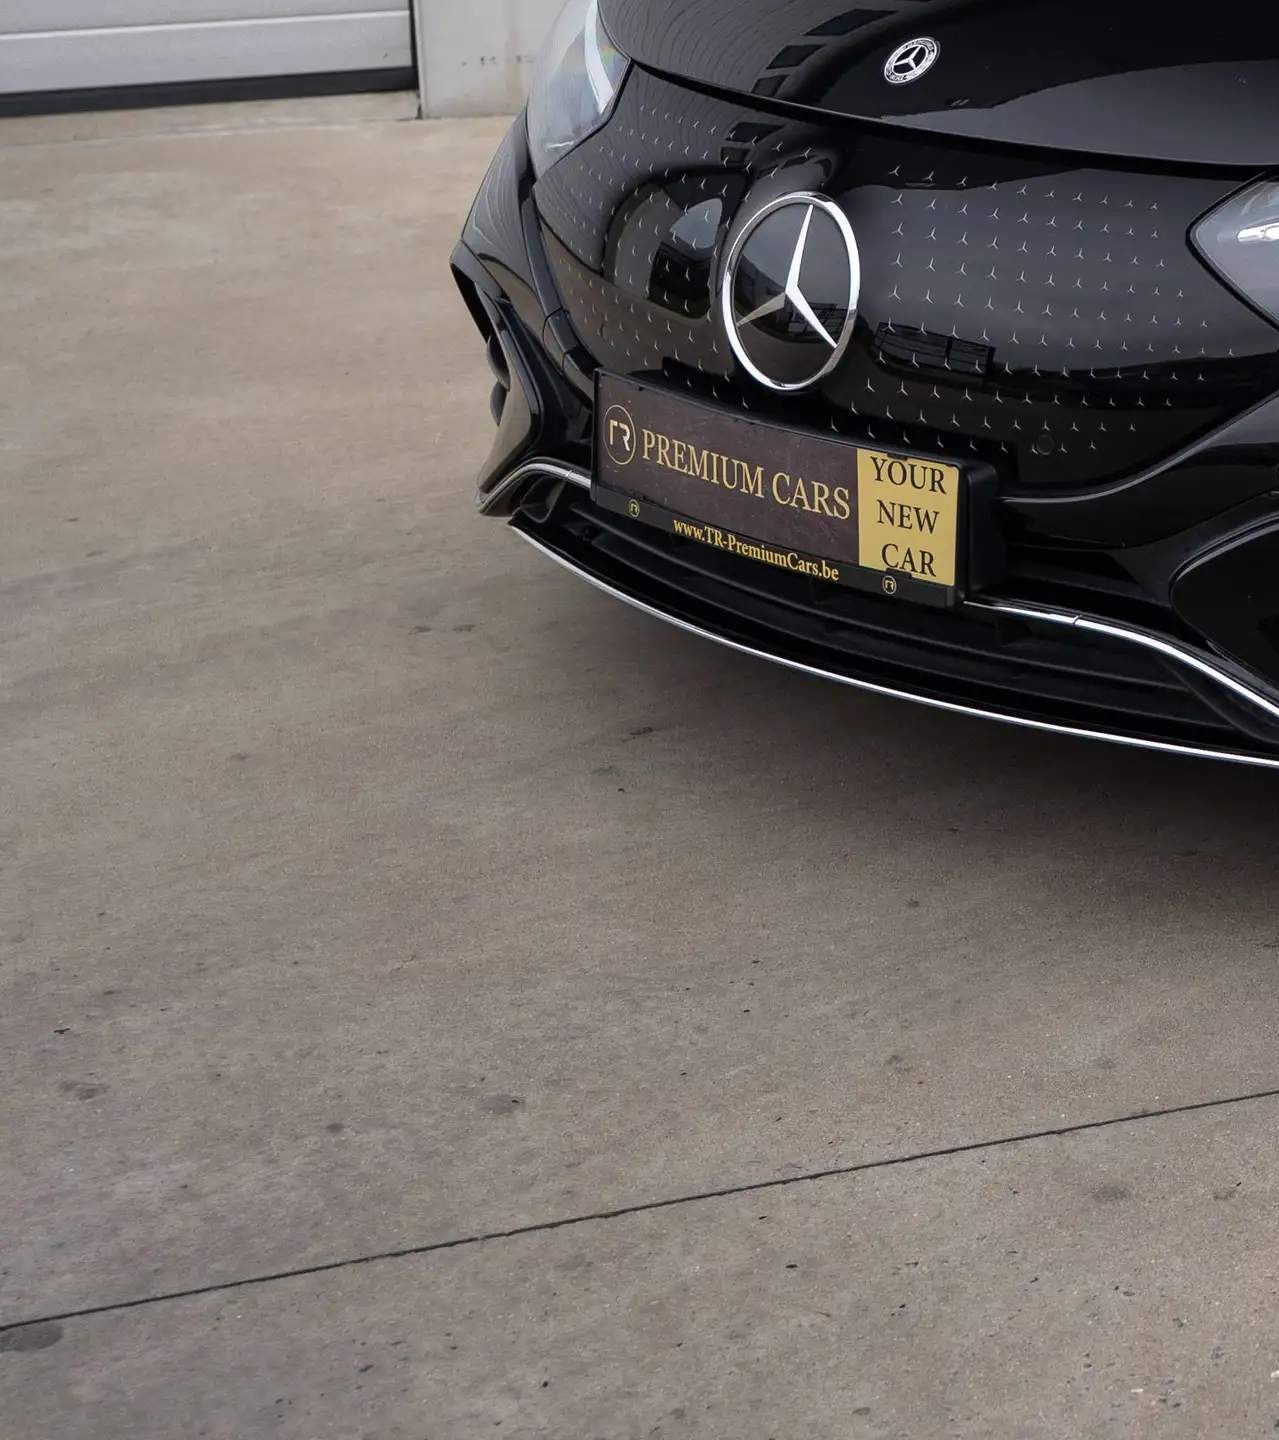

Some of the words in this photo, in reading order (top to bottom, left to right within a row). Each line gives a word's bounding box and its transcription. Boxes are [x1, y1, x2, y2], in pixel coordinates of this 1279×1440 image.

[641, 428, 765, 499] PREMIUM
[771, 471, 851, 520] CARS
[869, 455, 948, 495] YOUR
[876, 499, 941, 535] NEW
[672, 518, 840, 582] www.TR-PremiumCars.be
[881, 542, 937, 578] CAR
